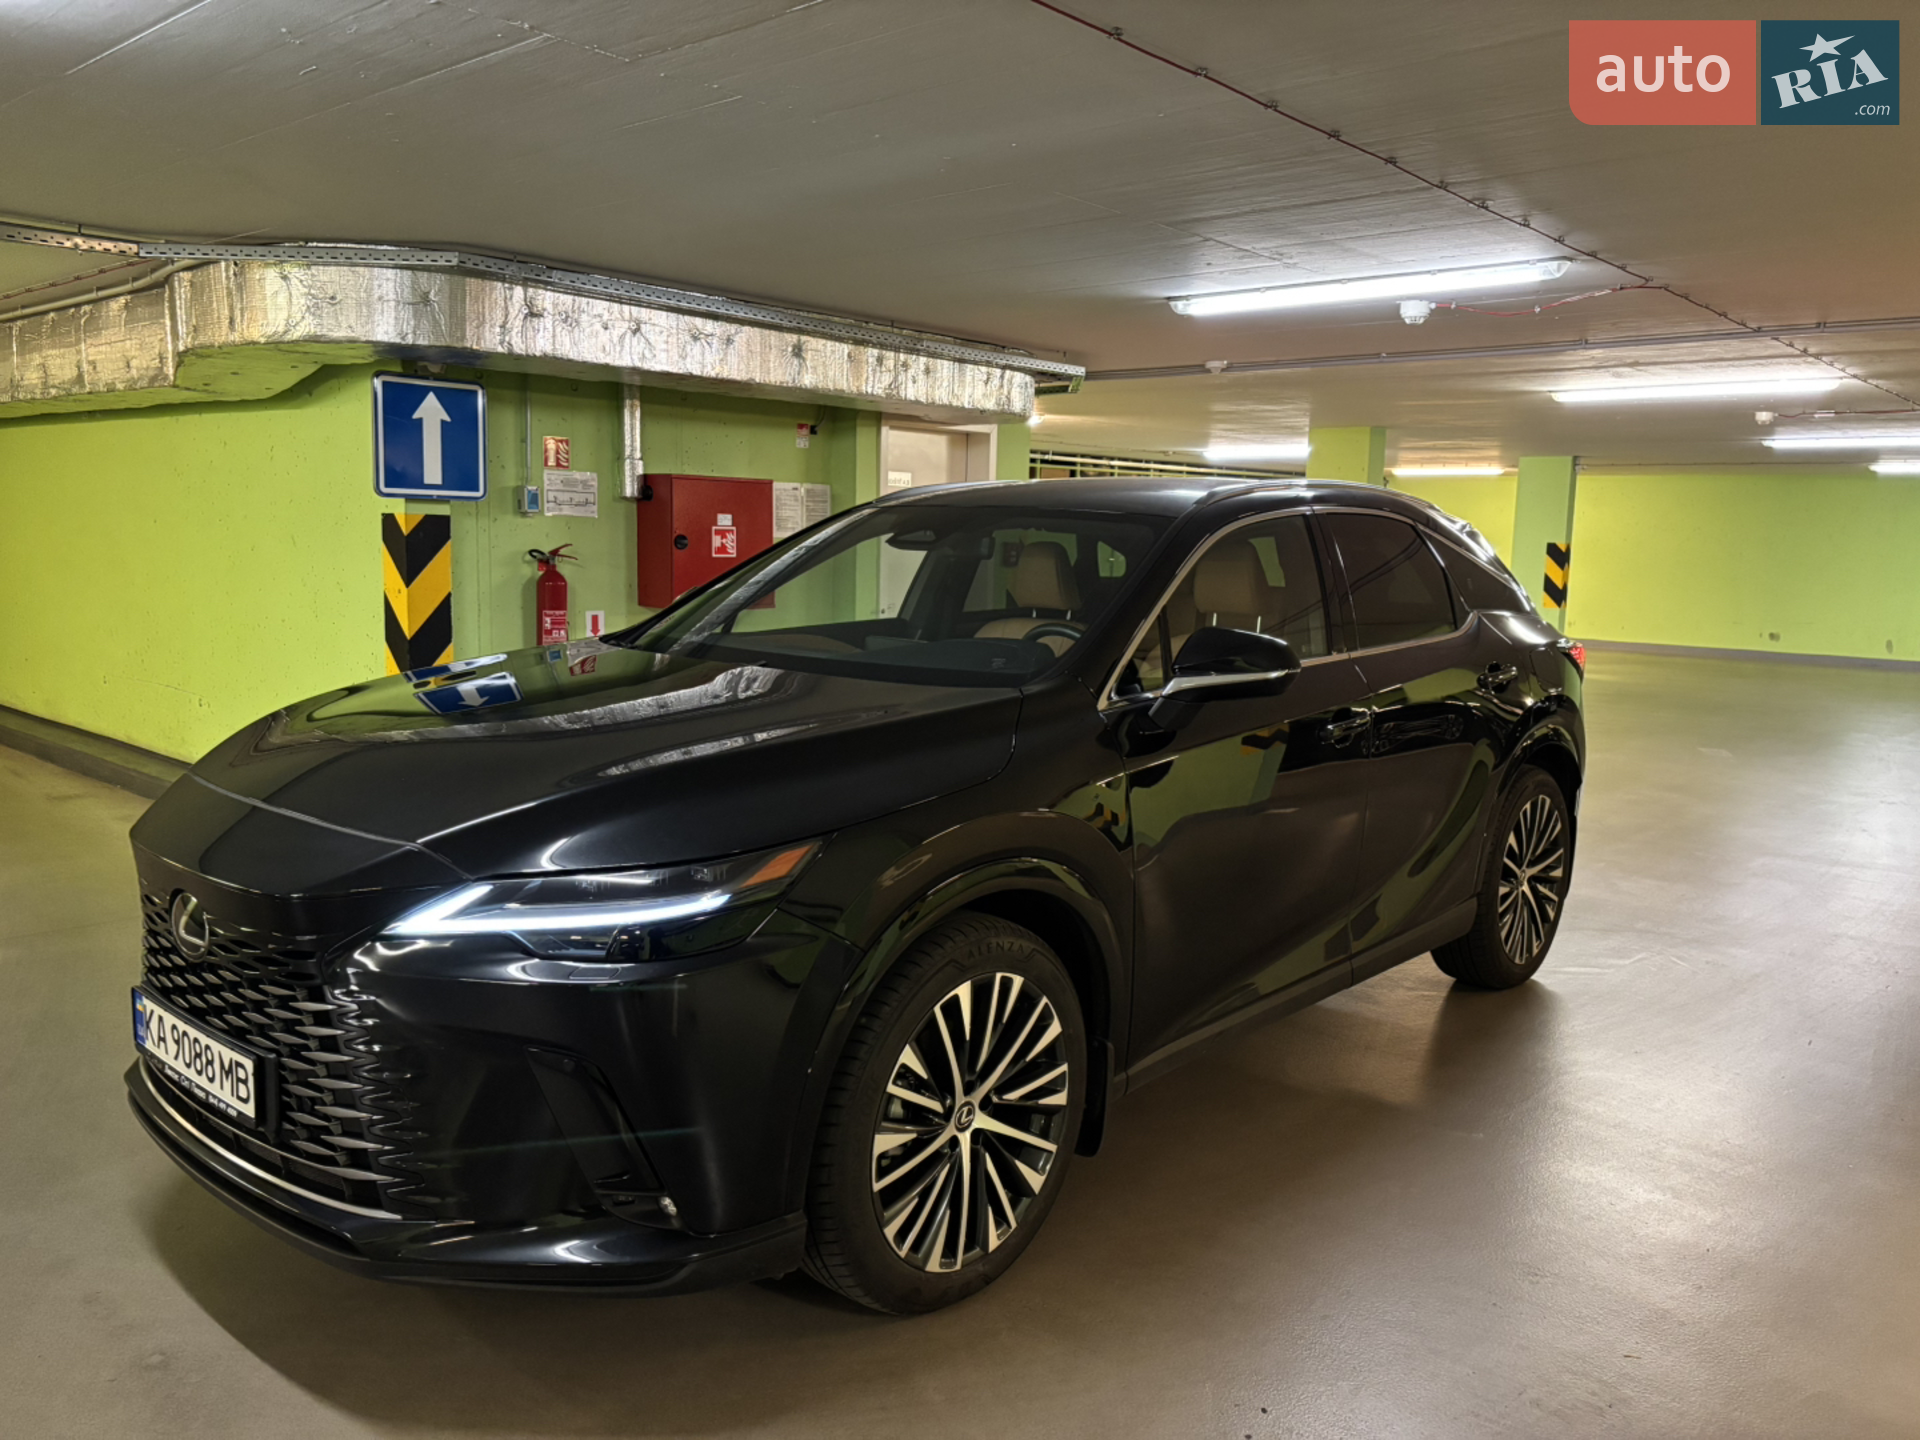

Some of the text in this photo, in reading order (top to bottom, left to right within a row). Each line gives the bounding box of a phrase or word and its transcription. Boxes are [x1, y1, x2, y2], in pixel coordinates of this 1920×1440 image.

[967, 941, 1025, 959] ALENZA
[143, 1003, 169, 1055] KA
[170, 1023, 216, 1084] 9088
[217, 1050, 251, 1105] MB
